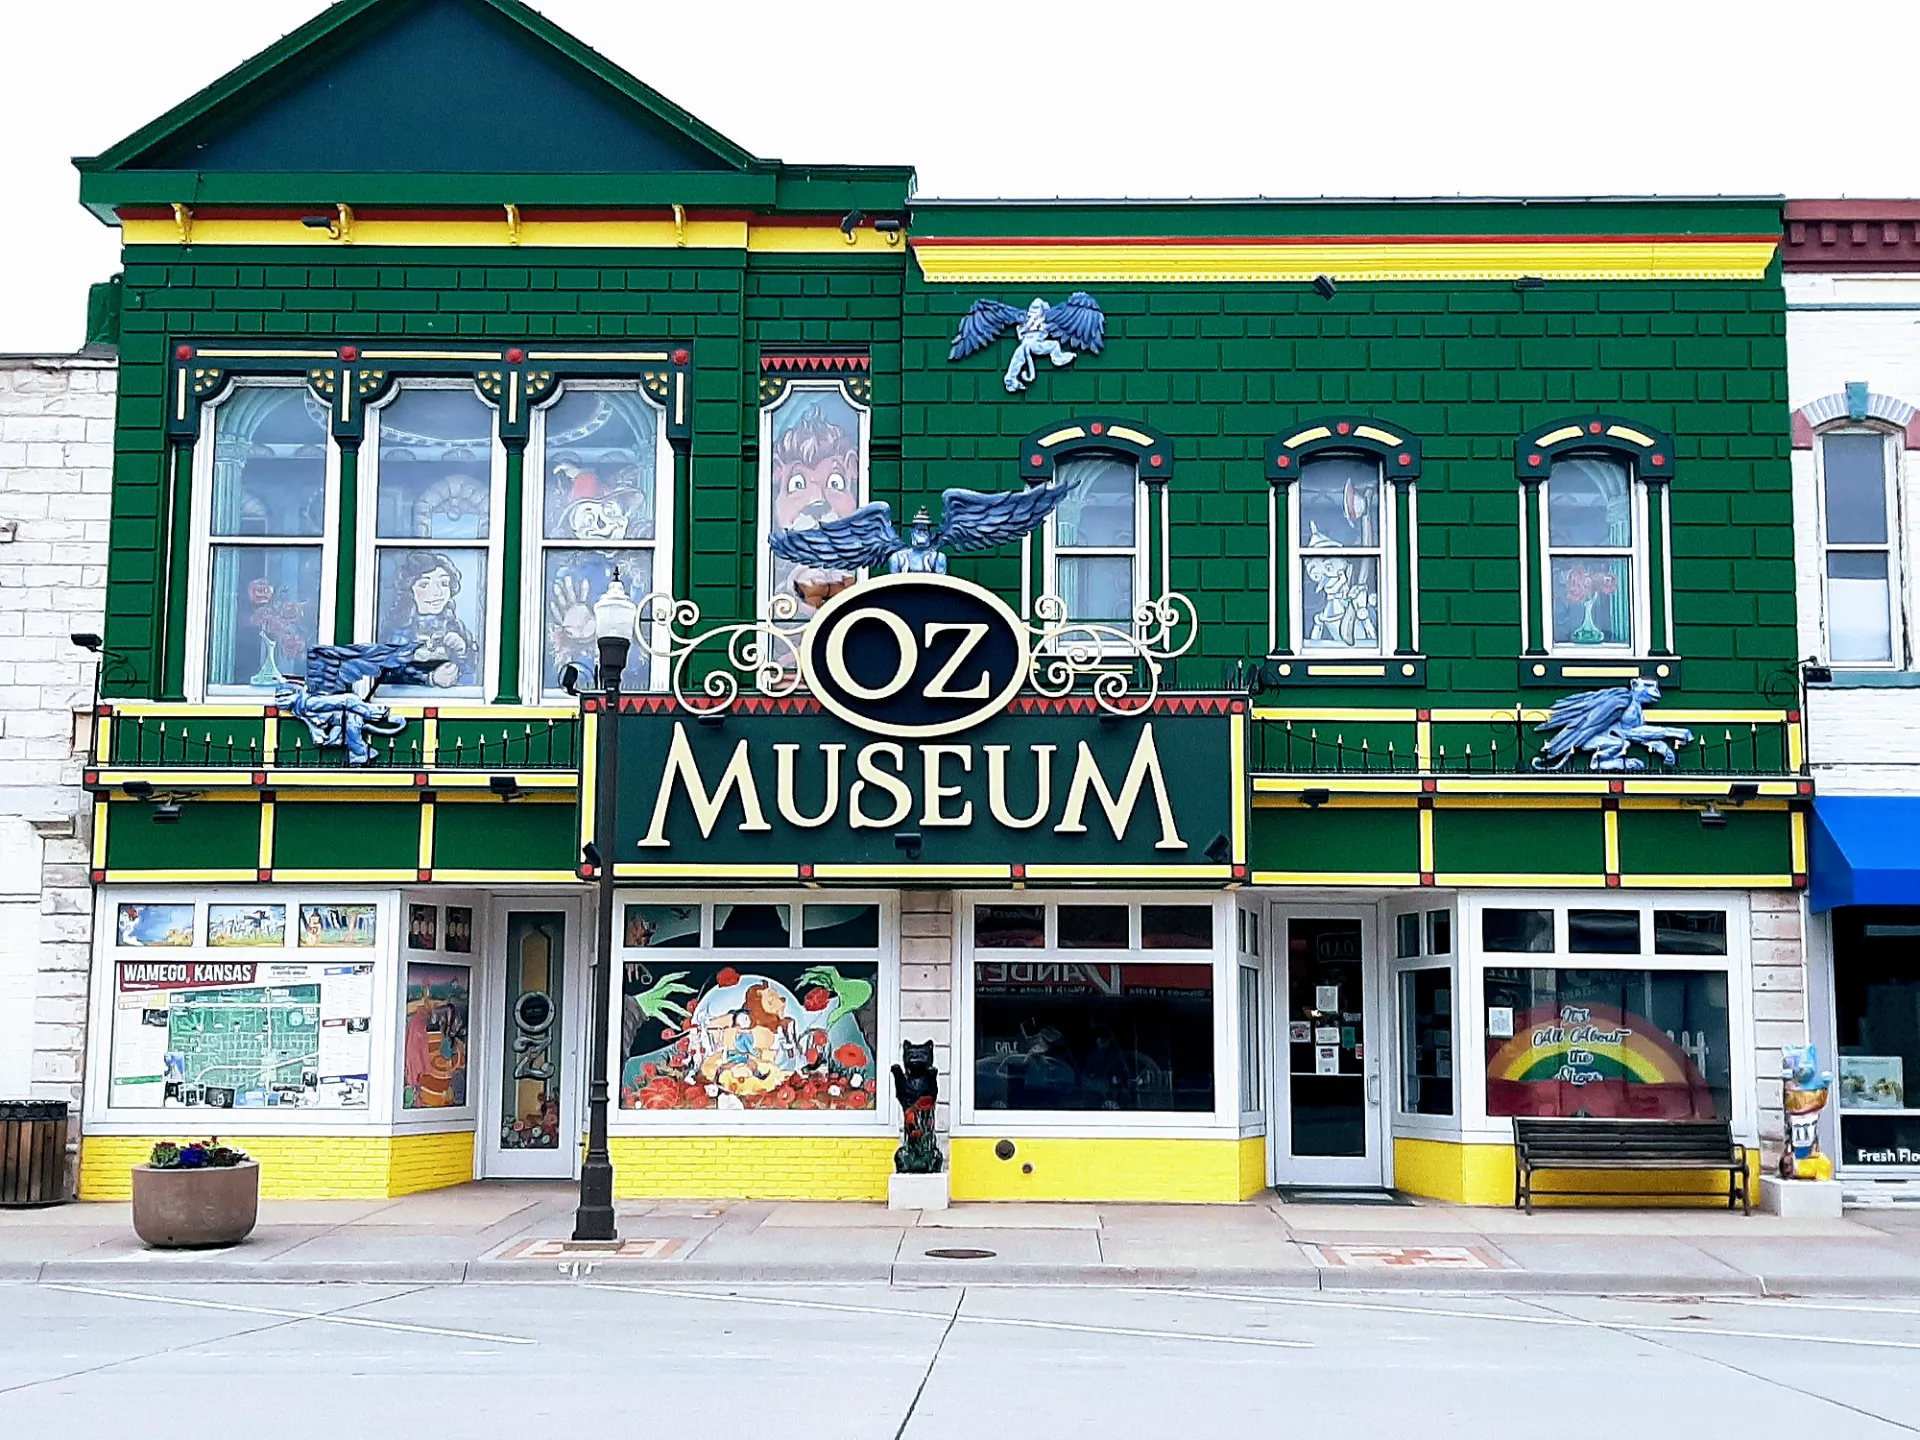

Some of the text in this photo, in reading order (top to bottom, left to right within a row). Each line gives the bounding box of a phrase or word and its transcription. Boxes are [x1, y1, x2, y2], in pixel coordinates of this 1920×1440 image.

[637, 722, 1188, 850] MUSEUM
[123, 964, 252, 984] WAMEGO, KANSAS
[1534, 1026, 1630, 1046] All About
[1858, 1148, 1896, 1162] Fresh
